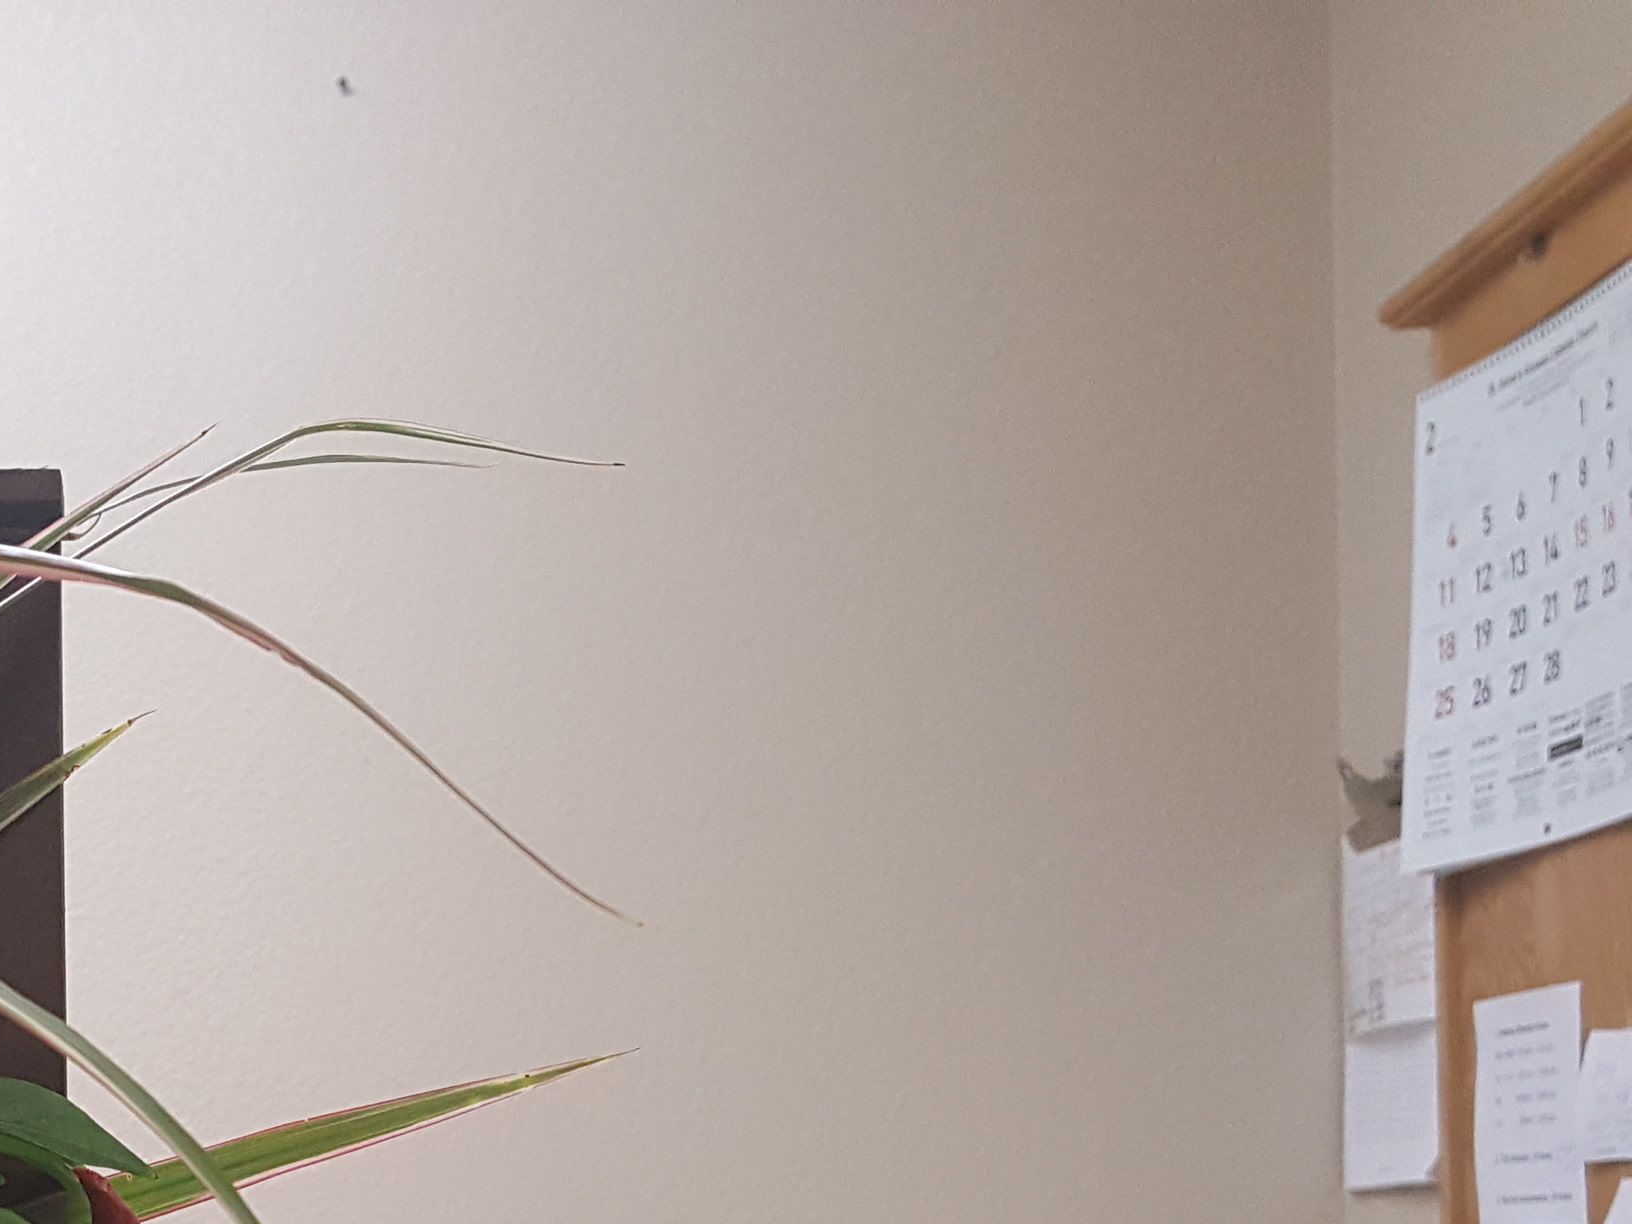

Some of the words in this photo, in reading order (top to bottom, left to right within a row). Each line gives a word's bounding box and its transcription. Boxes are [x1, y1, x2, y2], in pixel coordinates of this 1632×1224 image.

[1475, 561, 1492, 593] 12
[1508, 603, 1527, 639] 20
[1473, 674, 1491, 709] 26
[1543, 649, 1560, 683] 28
